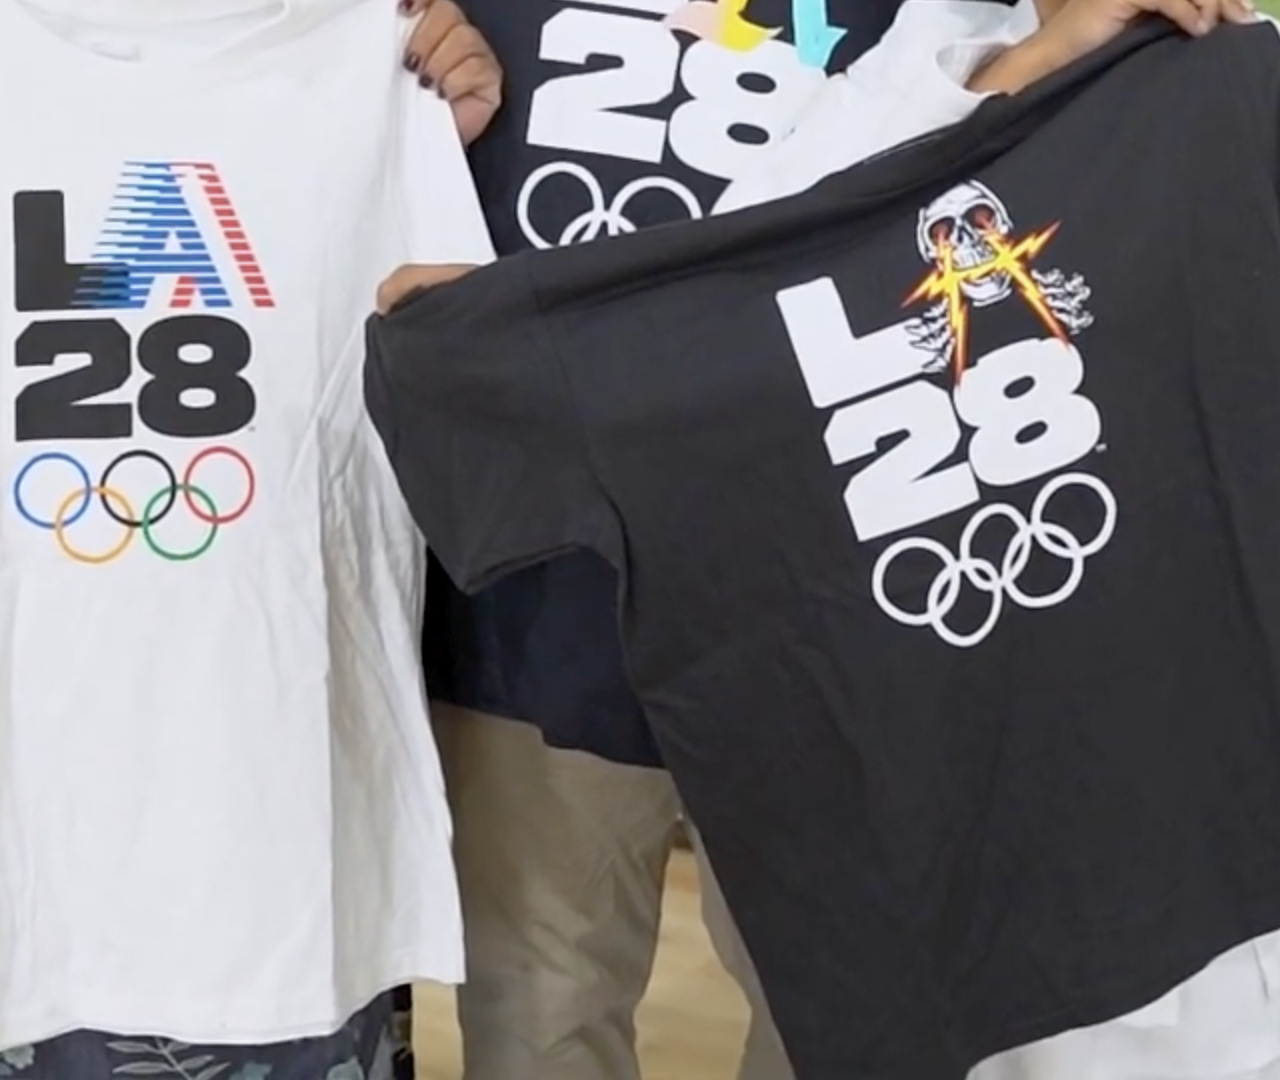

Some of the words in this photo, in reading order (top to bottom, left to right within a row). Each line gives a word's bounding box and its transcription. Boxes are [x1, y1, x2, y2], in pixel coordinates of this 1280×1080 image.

[526, 6, 828, 182] 28
[14, 161, 276, 312] LA
[15, 314, 256, 442] 28
[823, 337, 1102, 542] 28
